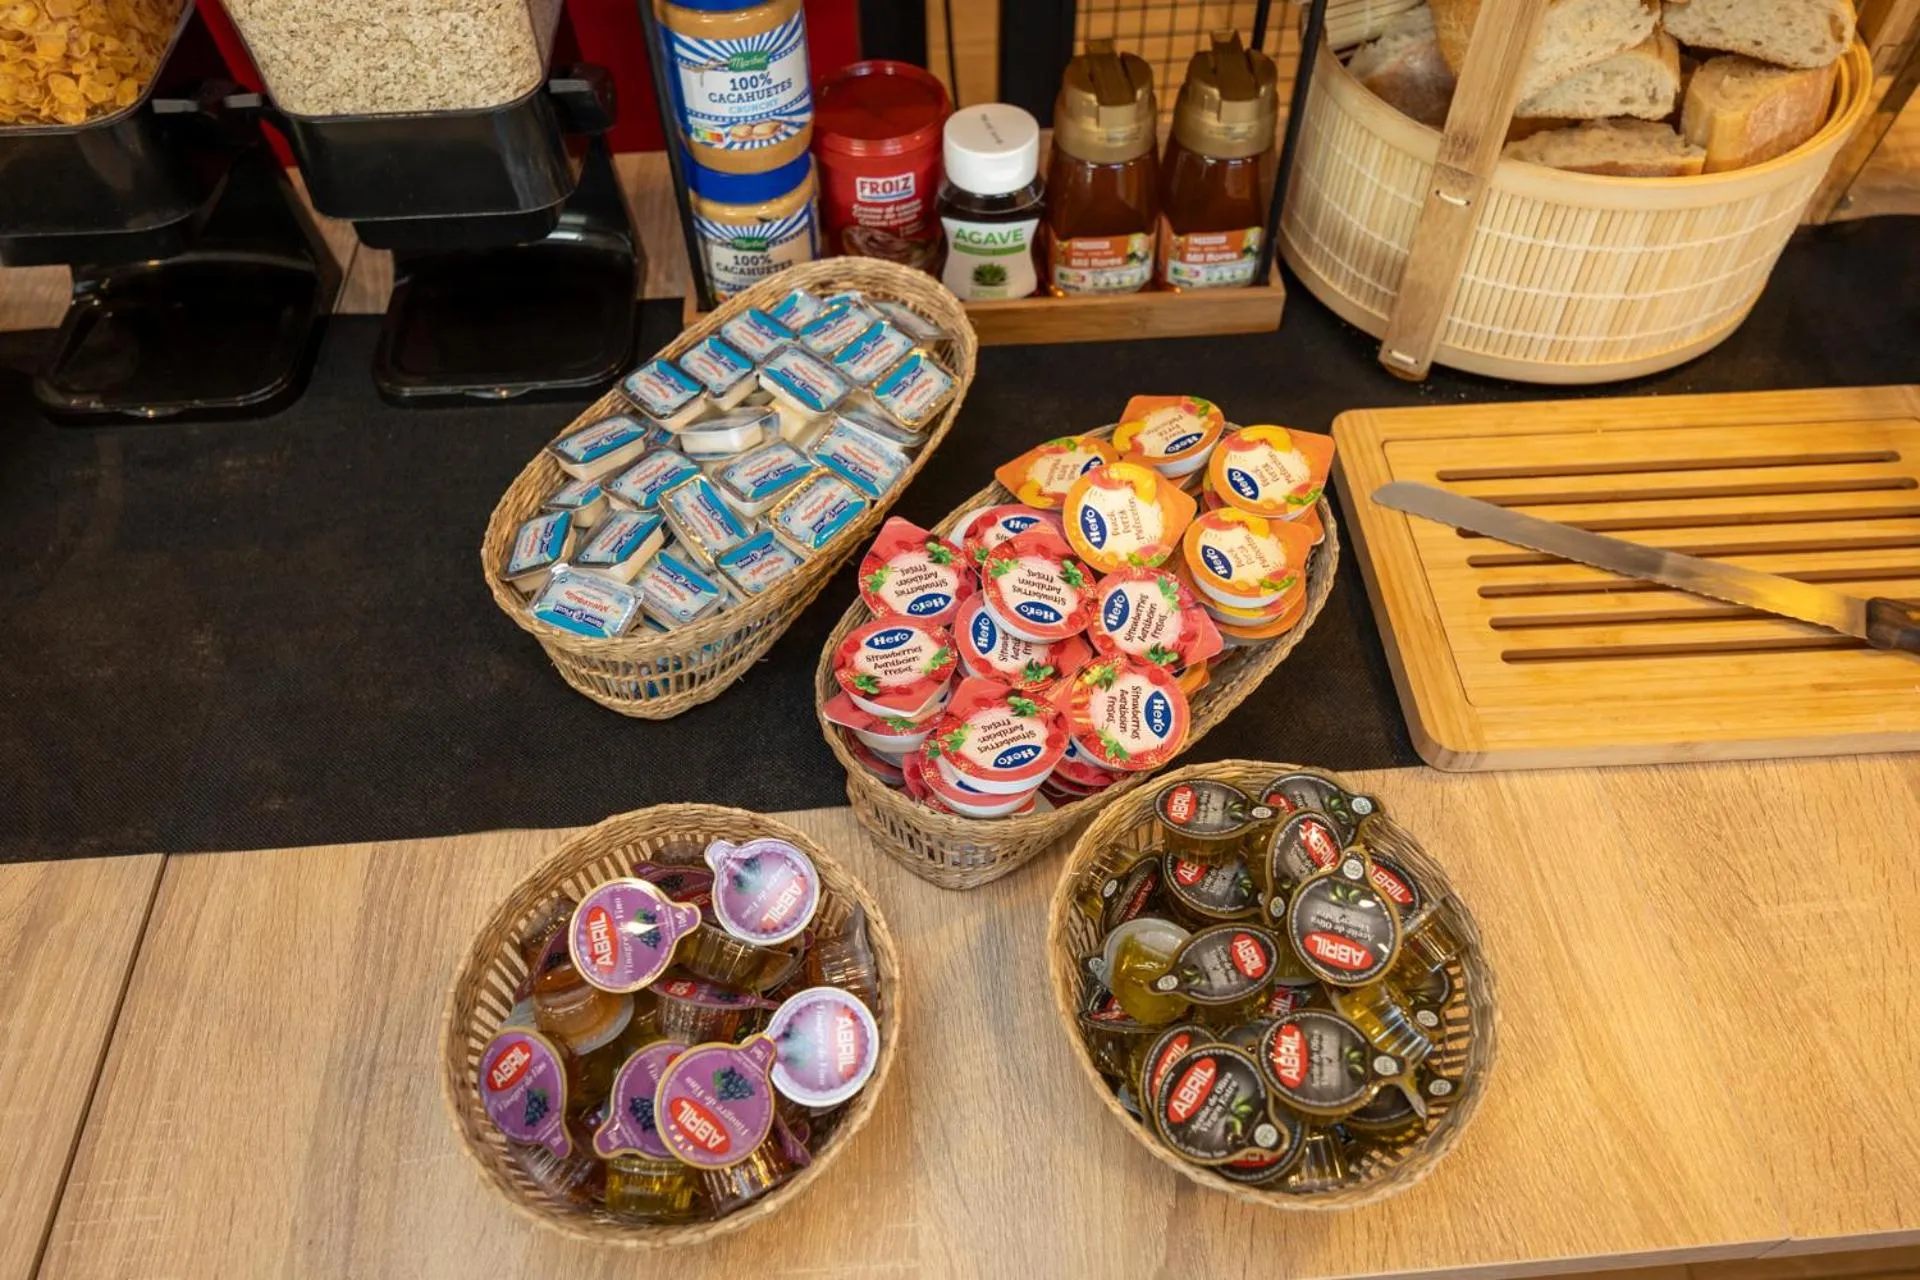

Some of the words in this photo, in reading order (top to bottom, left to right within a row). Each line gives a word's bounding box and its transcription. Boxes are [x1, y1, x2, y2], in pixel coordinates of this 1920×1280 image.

[708, 78, 792, 103] CACAHUETES
[729, 72, 772, 91] 100%
[860, 177, 910, 193] FROIZ
[955, 228, 1024, 244] AGAVE
[734, 254, 772, 266] 100%
[1167, 435, 1198, 453] Hero
[1231, 470, 1256, 496] Hero
[1085, 509, 1101, 543] Hero
[900, 564, 927, 577] Fresas
[1027, 568, 1054, 583] Fresas
[1206, 548, 1229, 575] Hero
[894, 578, 948, 597] Strawberries
[1011, 584, 1067, 606] Strawberries
[1018, 577, 1062, 594] Aardbeien
[911, 597, 946, 612] Hero
[1020, 604, 1055, 621] Hero
[1107, 594, 1126, 626] Hero
[1124, 594, 1149, 642] Strawberries
[977, 617, 990, 648] Hero
[1138, 603, 1157, 642] Aardbeien
[1151, 614, 1168, 639] Fresas
[873, 632, 910, 646] Hero
[865, 646, 921, 662] Strawberries
[1106, 695, 1117, 724] Fresas
[1119, 689, 1129, 733] Aardbeien
[1131, 685, 1142, 740] Strawberries
[1153, 698, 1165, 732] Hero
[978, 724, 1024, 743] Aardbeien
[981, 719, 1011, 733] Fresas
[977, 730, 1037, 753] Strawberries
[998, 748, 1035, 765] Hero
[1171, 790, 1192, 821] ABRIL
[761, 879, 803, 924] ABRIL
[590, 912, 614, 966] ABRIL
[1302, 935, 1366, 967] ABRIL
[1233, 939, 1263, 976] ABRIL
[836, 1016, 856, 1072] ABRIL
[1278, 1031, 1301, 1082] ABRIL
[492, 1047, 530, 1088] ABRIL
[685, 1076, 705, 1098] Vino
[716, 1104, 750, 1136] Vinagre
[1171, 1067, 1216, 1119] ABRIL
[1191, 1106, 1212, 1133] Aceite
[1214, 1072, 1234, 1095] Oliva
[1199, 1105, 1223, 1132] Virgen
[1219, 1080, 1238, 1106] Extra
[678, 1100, 727, 1139] ABRIL
